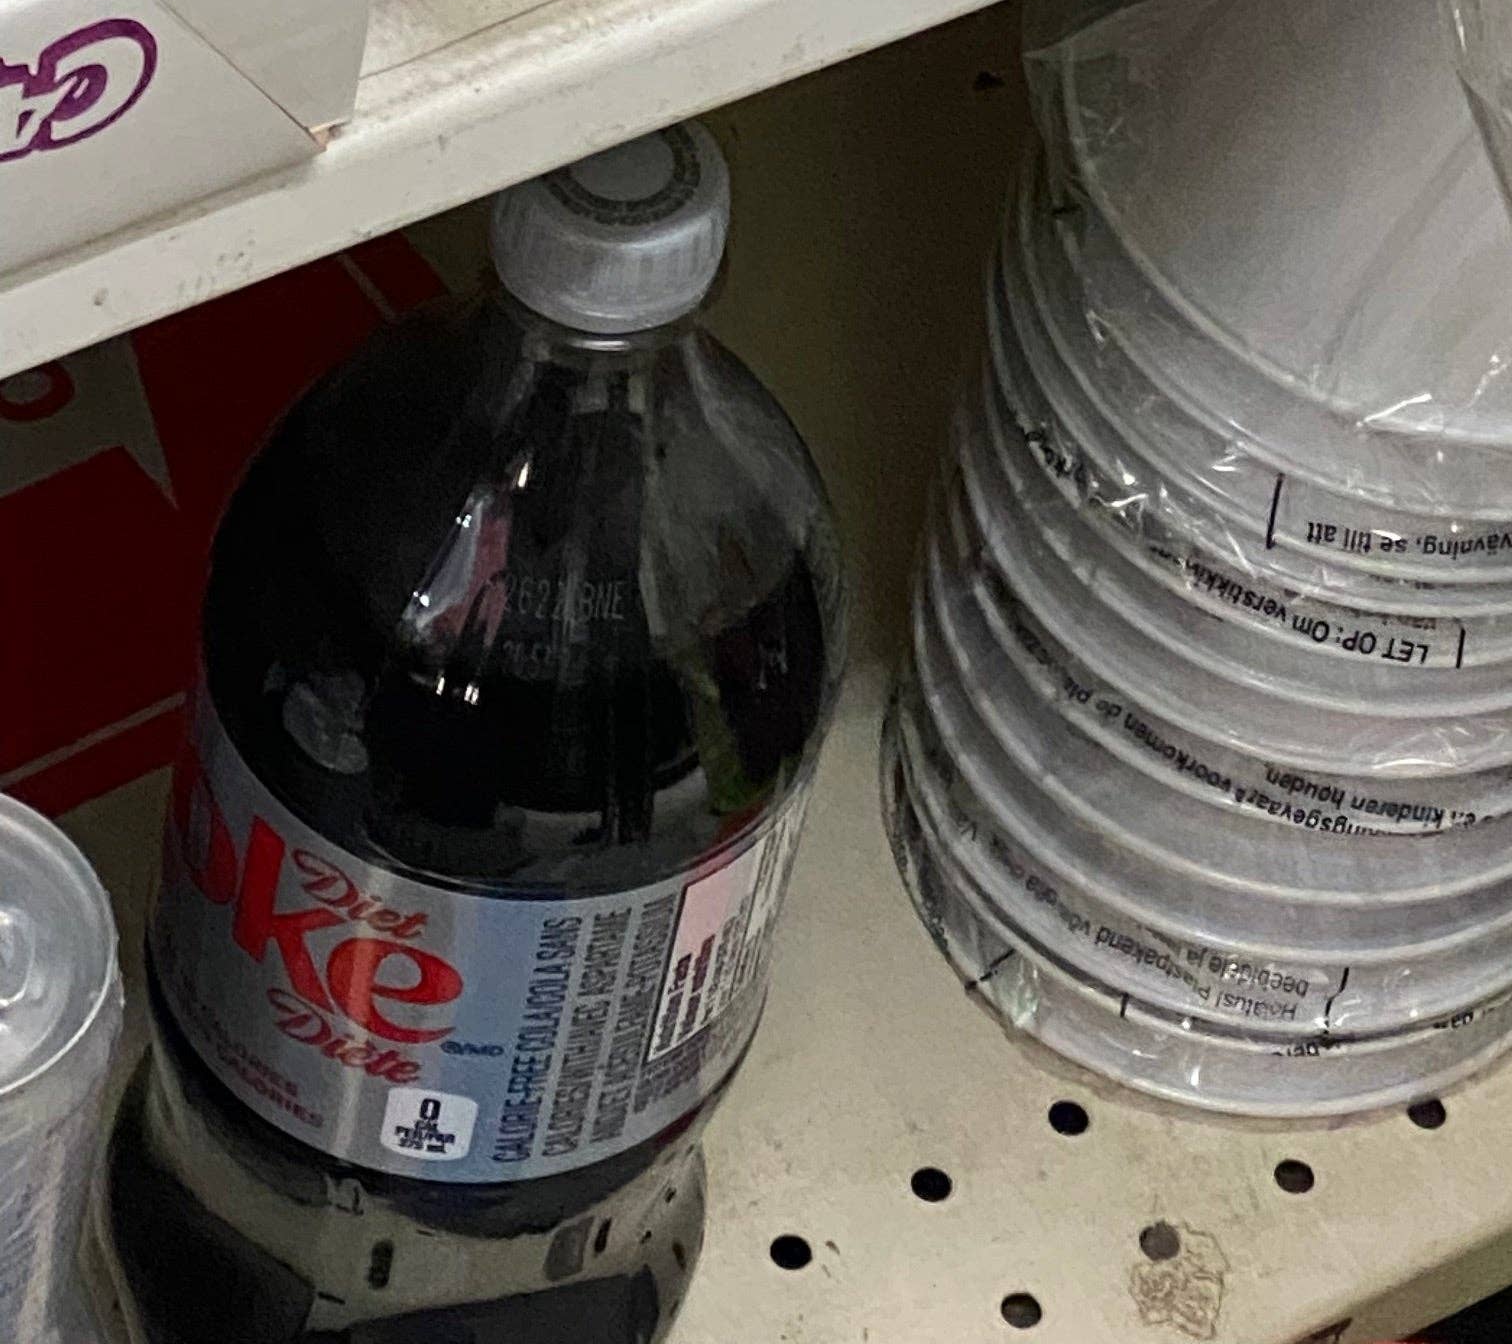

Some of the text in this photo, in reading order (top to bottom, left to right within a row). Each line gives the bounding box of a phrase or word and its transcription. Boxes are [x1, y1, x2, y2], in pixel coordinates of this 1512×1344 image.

[1304, 519, 1337, 546] att
[1341, 525, 1372, 557] till
[1379, 532, 1407, 555] se
[1288, 612, 1430, 666] LET OP: Om
[1119, 711, 1236, 795] voorkomen
[1347, 788, 1447, 829] kinderen
[294, 850, 429, 941] Diet
[577, 907, 631, 995] ASPARTAME
[1092, 922, 1215, 1002] Plastpakend
[267, 987, 423, 1087] Diète
[491, 917, 582, 1163] CALORIE-FREE COLA/COLA SANS
[420, 1098, 441, 1120] 0
